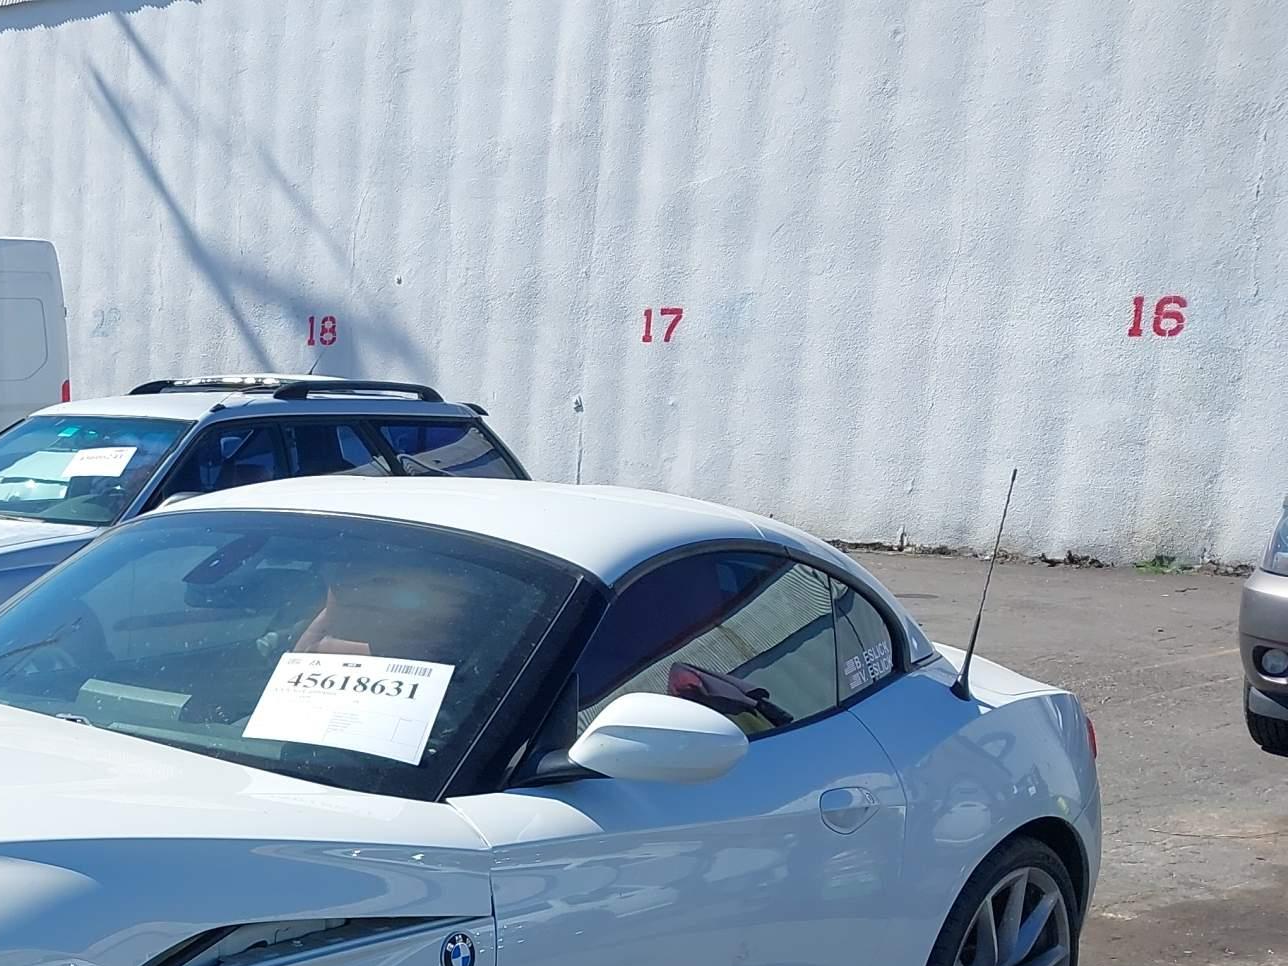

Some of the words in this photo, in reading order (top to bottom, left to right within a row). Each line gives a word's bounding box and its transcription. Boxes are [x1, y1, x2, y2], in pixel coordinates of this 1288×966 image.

[306, 314, 338, 347] 18
[641, 306, 684, 343] 17
[1127, 294, 1188, 338] 16
[862, 640, 890, 665] ESLICK
[287, 671, 420, 700] 45618631
